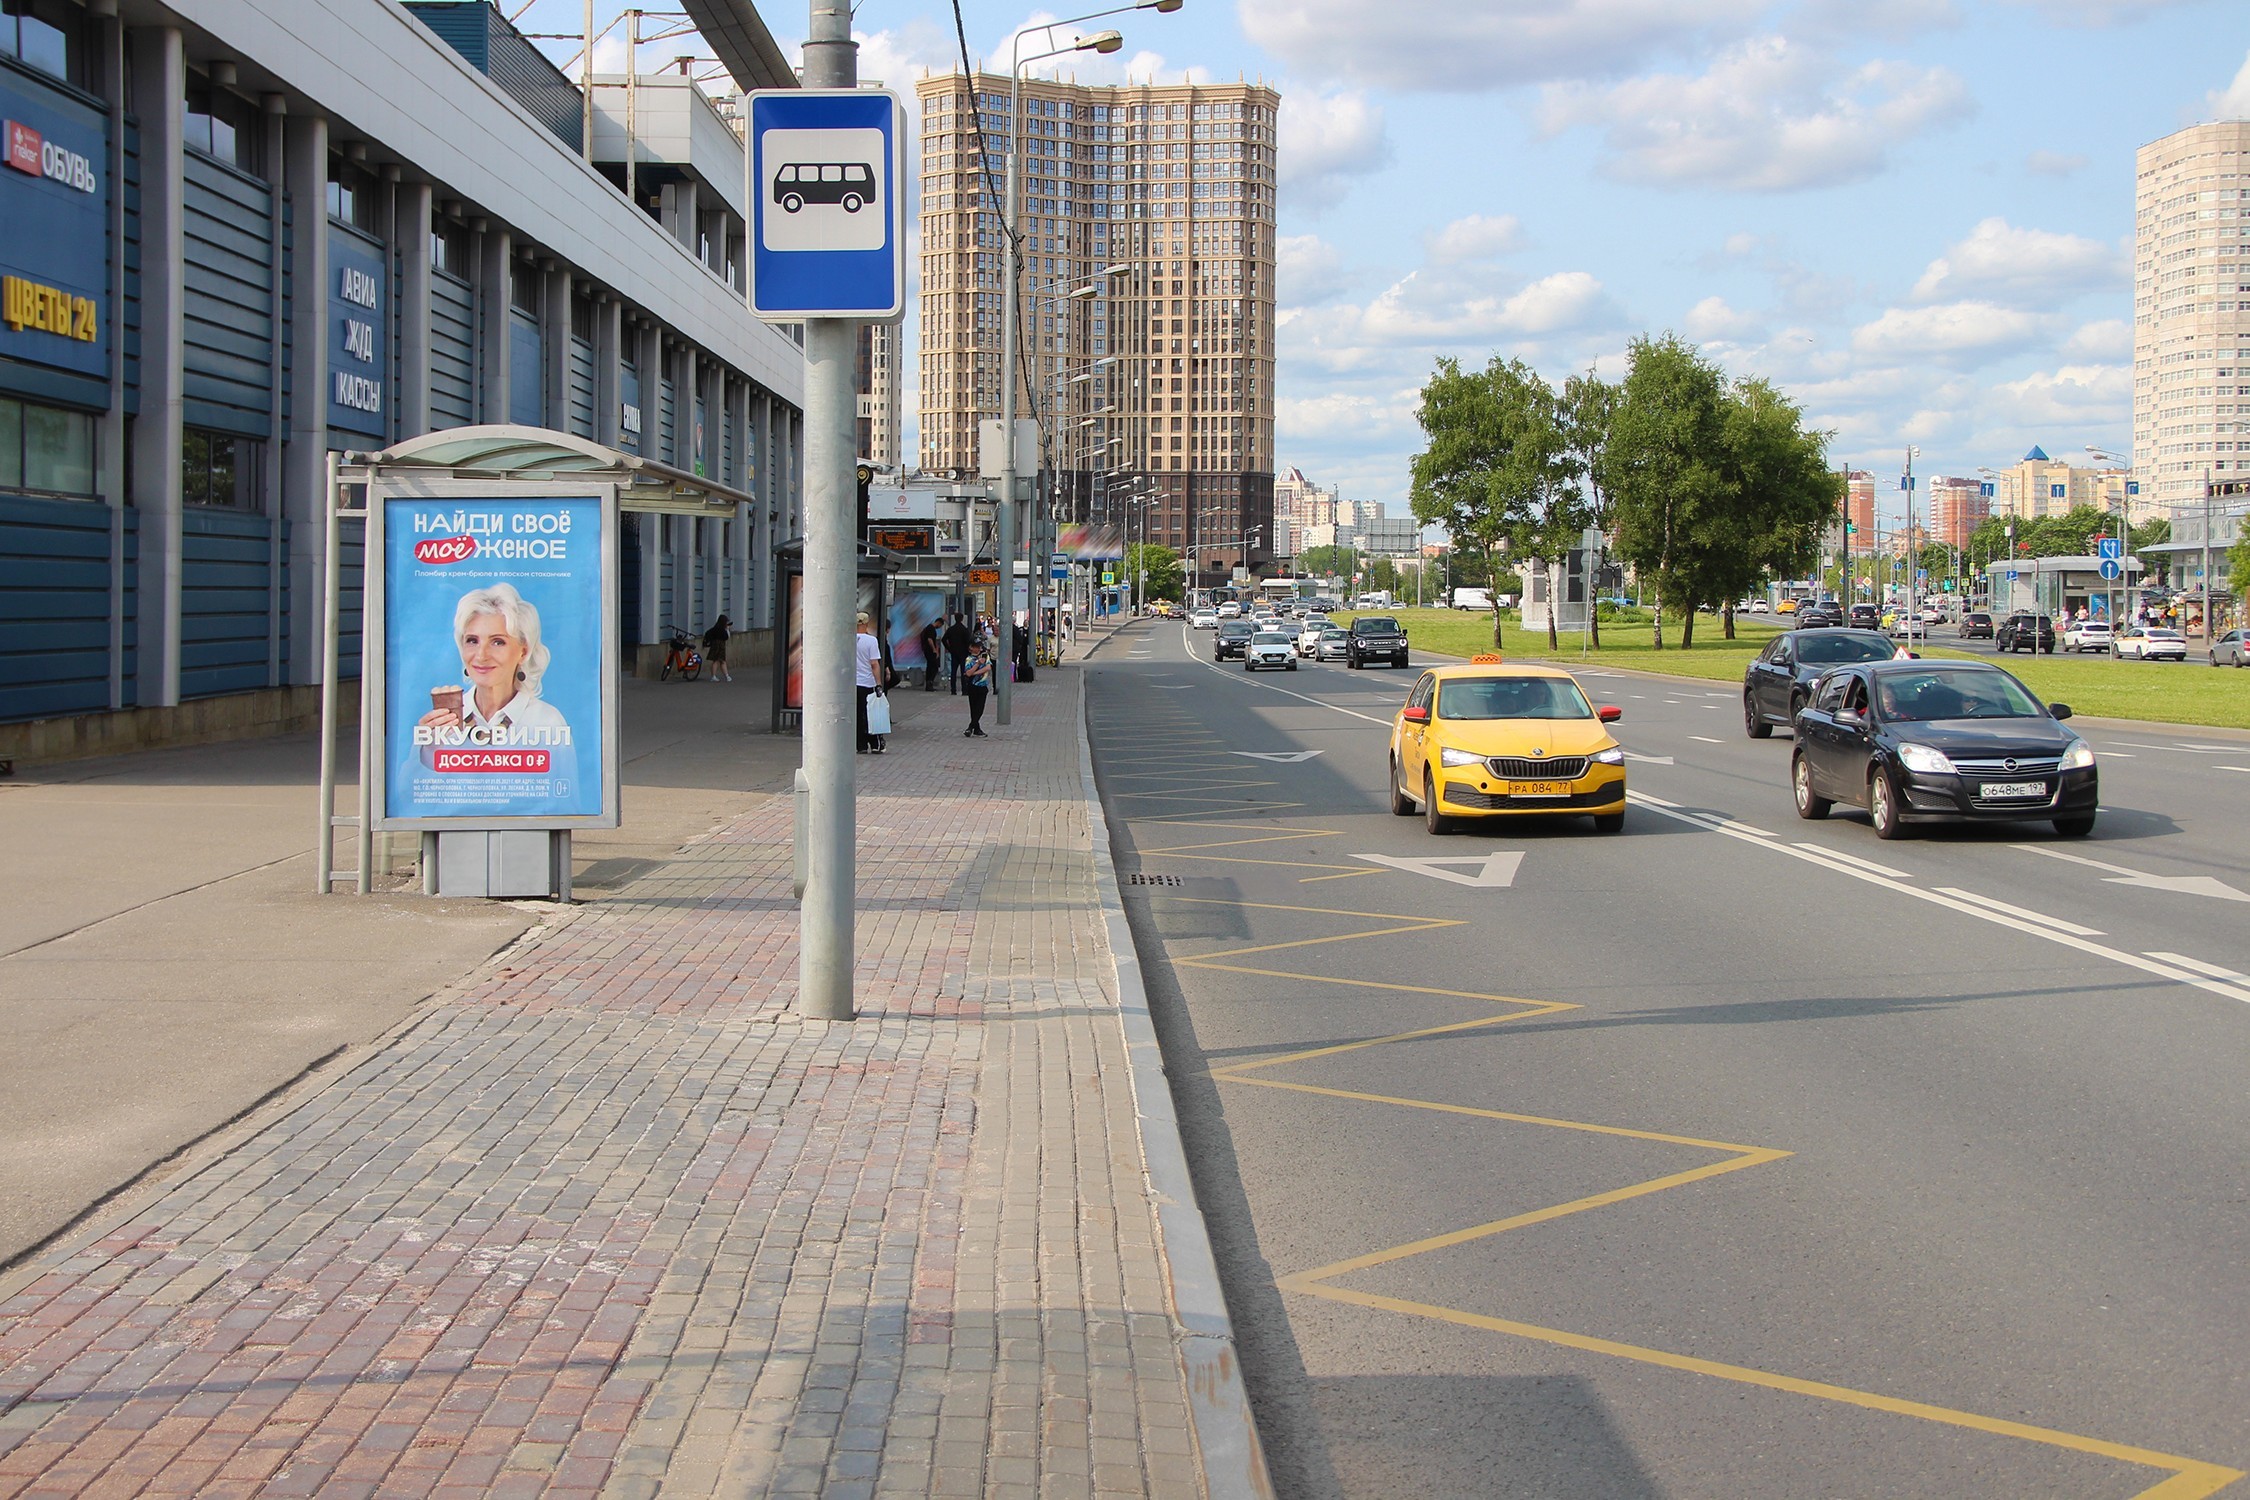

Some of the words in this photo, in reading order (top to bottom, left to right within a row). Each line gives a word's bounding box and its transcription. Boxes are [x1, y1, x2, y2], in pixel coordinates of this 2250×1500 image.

[42, 140, 96, 194] ОБУВЬ
[341, 267, 376, 309] АВИА
[4, 275, 72, 336] ЦВЕТЫ
[73, 296, 97, 342] 24
[345, 319, 373, 362] Ж/Д
[336, 372, 380, 412] КАССЫ
[414, 509, 504, 537] НАЙДИ
[414, 569, 447, 578] Пломбир
[448, 570, 493, 578] крем-брюле
[413, 725, 571, 747] ВКУСВИЛЛ
[438, 754, 522, 769] ДОСТАВКА
[556, 781, 569, 796] 0+
[1514, 785, 1527, 793] РА
[1531, 783, 1552, 793] 084
[1557, 782, 1568, 790] 77
[2028, 783, 2043, 792] 197
